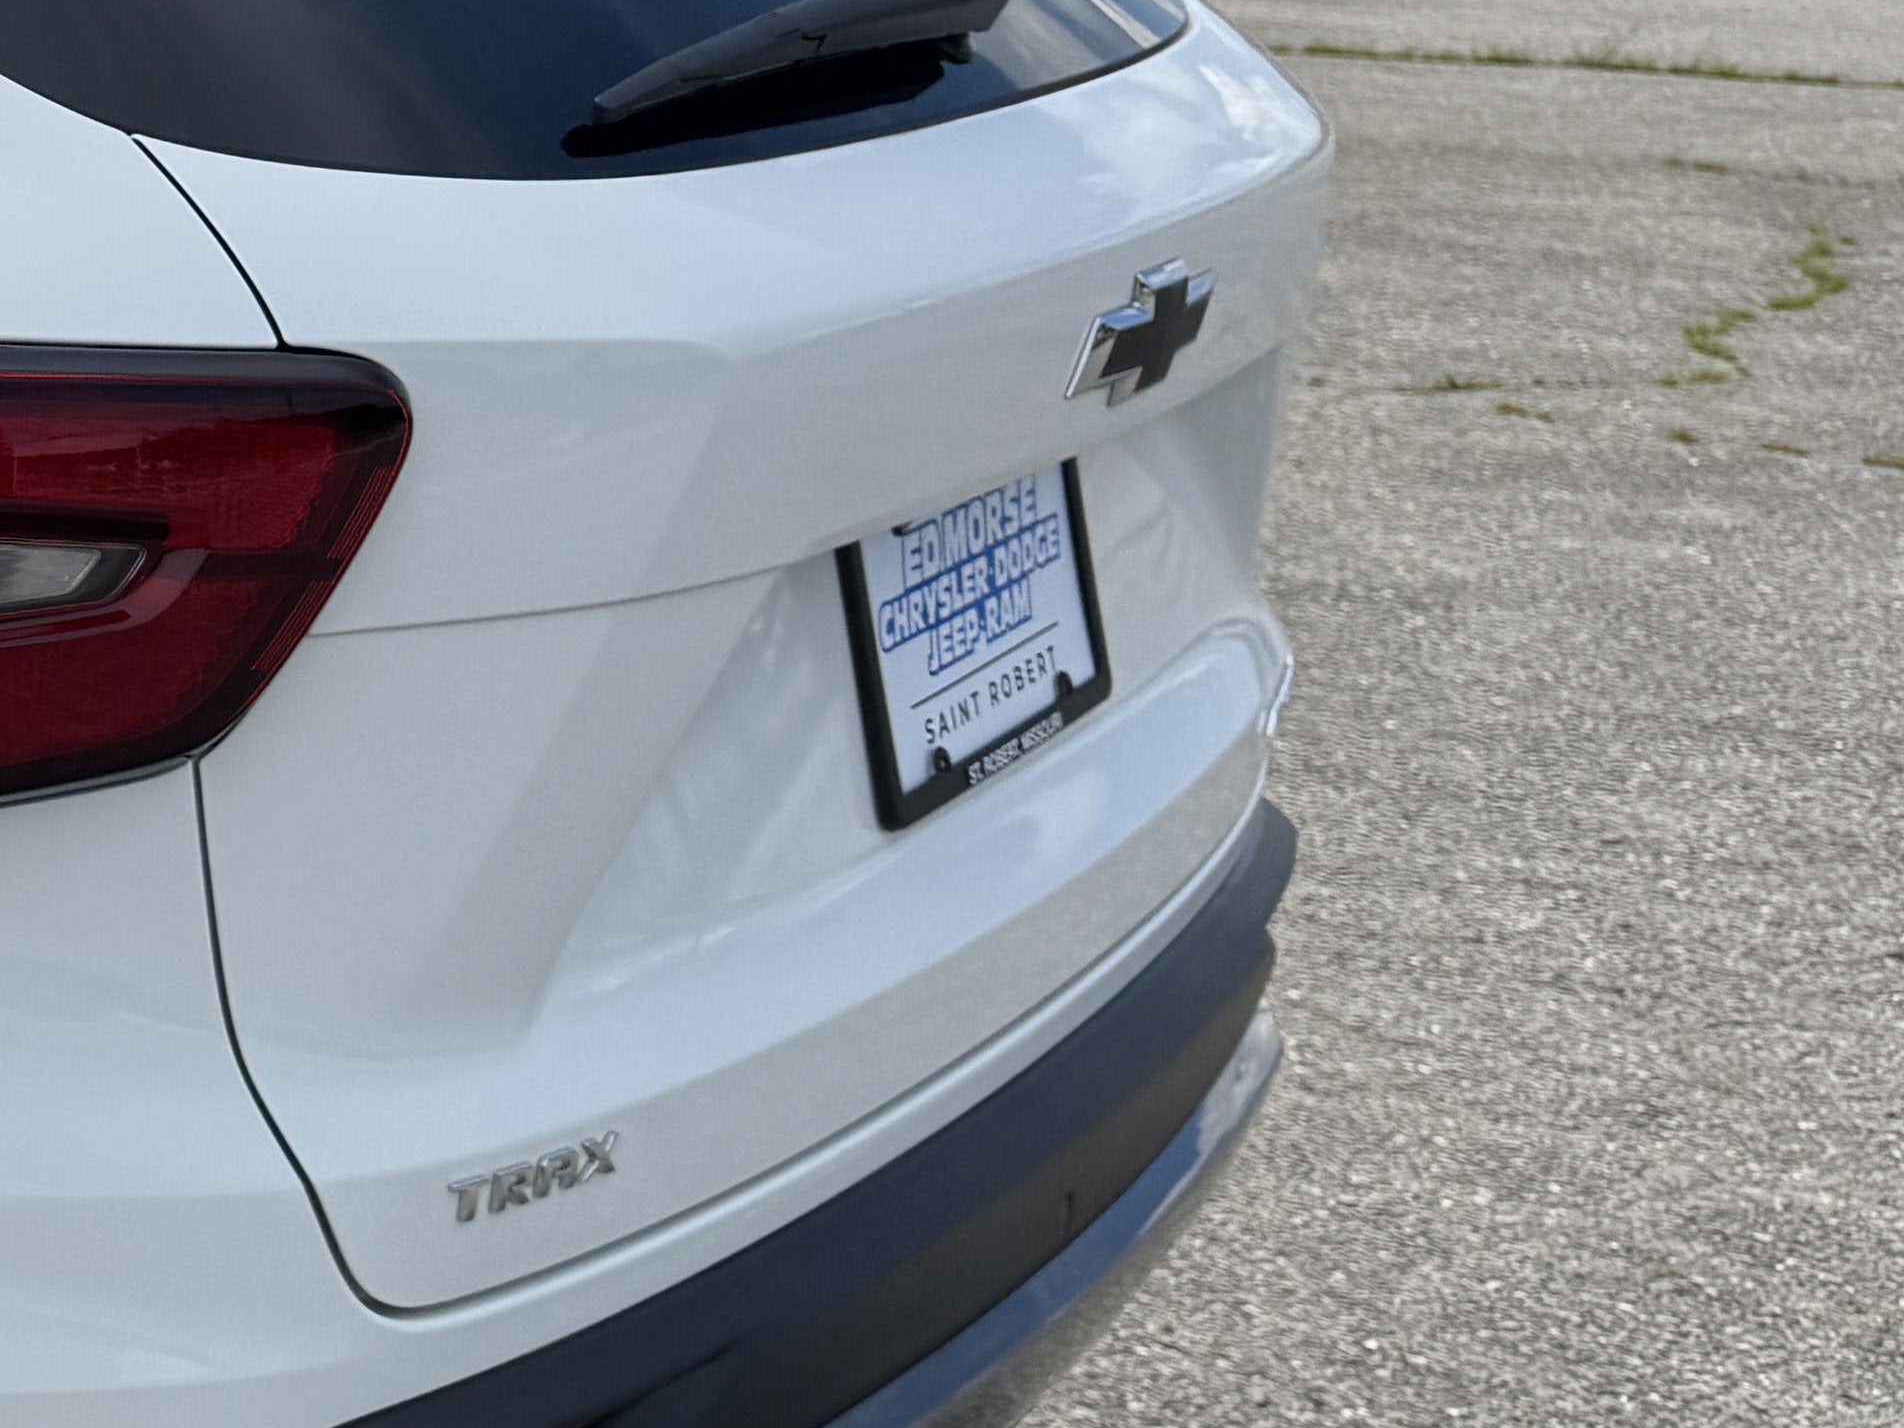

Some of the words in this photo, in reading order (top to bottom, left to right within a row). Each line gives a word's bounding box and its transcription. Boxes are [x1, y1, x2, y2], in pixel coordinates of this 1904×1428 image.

[878, 551, 990, 653] CHRYSLER
[993, 515, 1060, 588] DODGE
[901, 518, 941, 593] ED
[940, 475, 1036, 570] MORSE
[928, 603, 979, 675] JEEP
[983, 574, 1032, 643] RAM
[924, 691, 979, 745] SAINT
[989, 645, 1059, 707] ROBERT
[447, 1129, 620, 1223] TRAX
